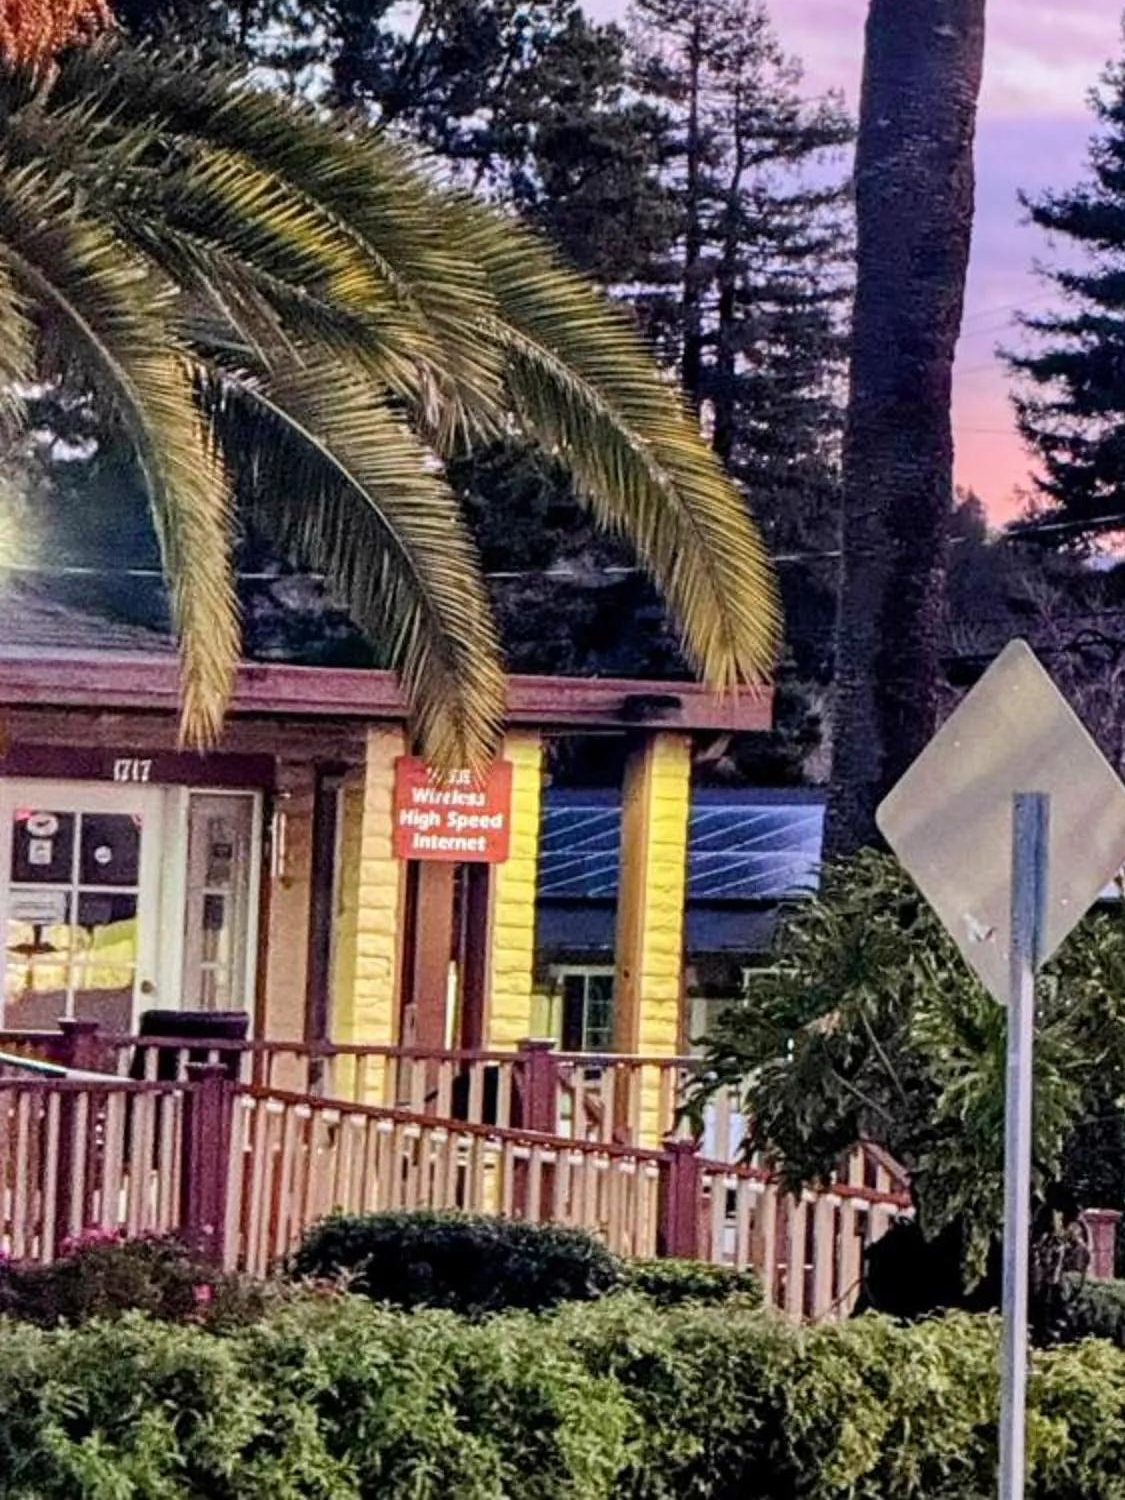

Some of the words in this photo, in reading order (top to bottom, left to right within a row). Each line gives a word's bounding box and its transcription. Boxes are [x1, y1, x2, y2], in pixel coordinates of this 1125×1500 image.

[113, 758, 152, 782] 1717
[411, 786, 486, 807] Wireless
[399, 807, 441, 831] High
[447, 809, 503, 832] Speed
[412, 831, 487, 852] Internet
